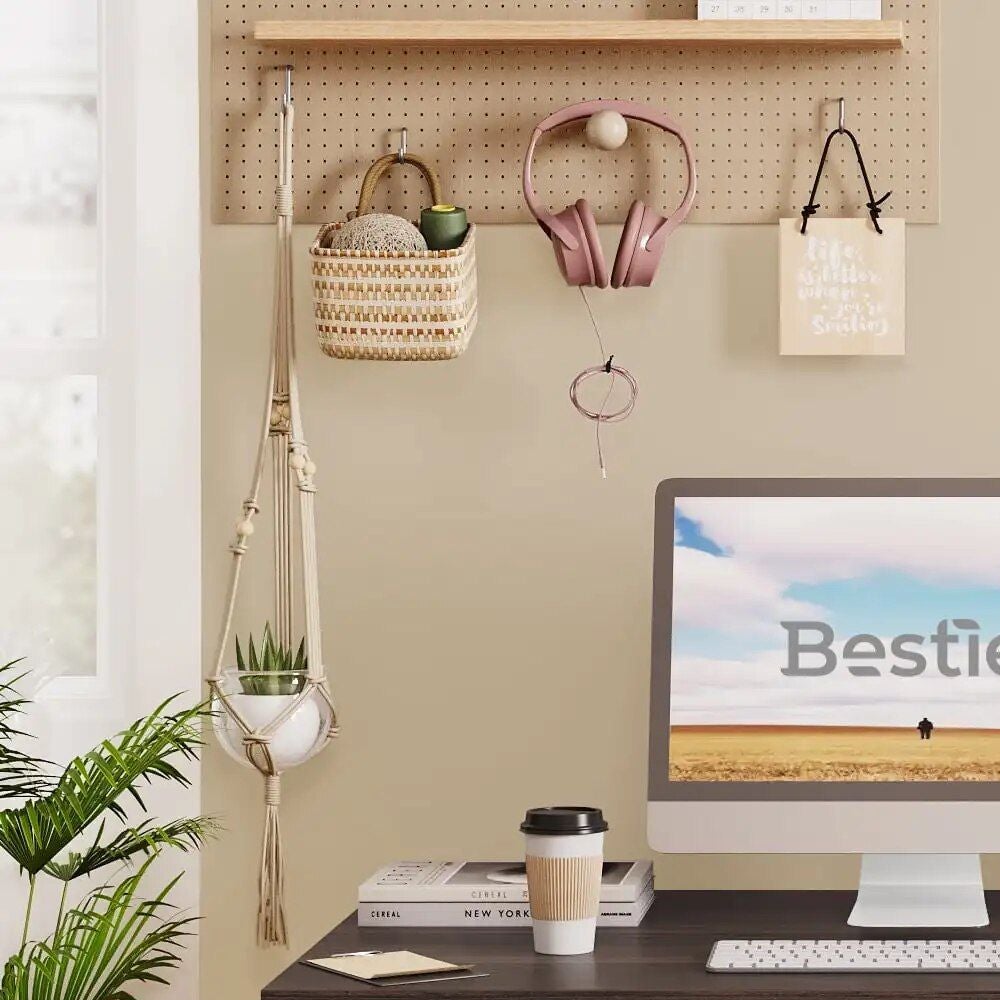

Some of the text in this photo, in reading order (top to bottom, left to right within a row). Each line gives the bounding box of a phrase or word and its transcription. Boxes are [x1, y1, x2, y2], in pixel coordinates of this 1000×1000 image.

[711, 5, 720, 13] 27
[760, 5, 769, 13] 29
[370, 910, 401, 919] CEREAL
[464, 909, 493, 919] NEW
[499, 909, 530, 919] YORK
